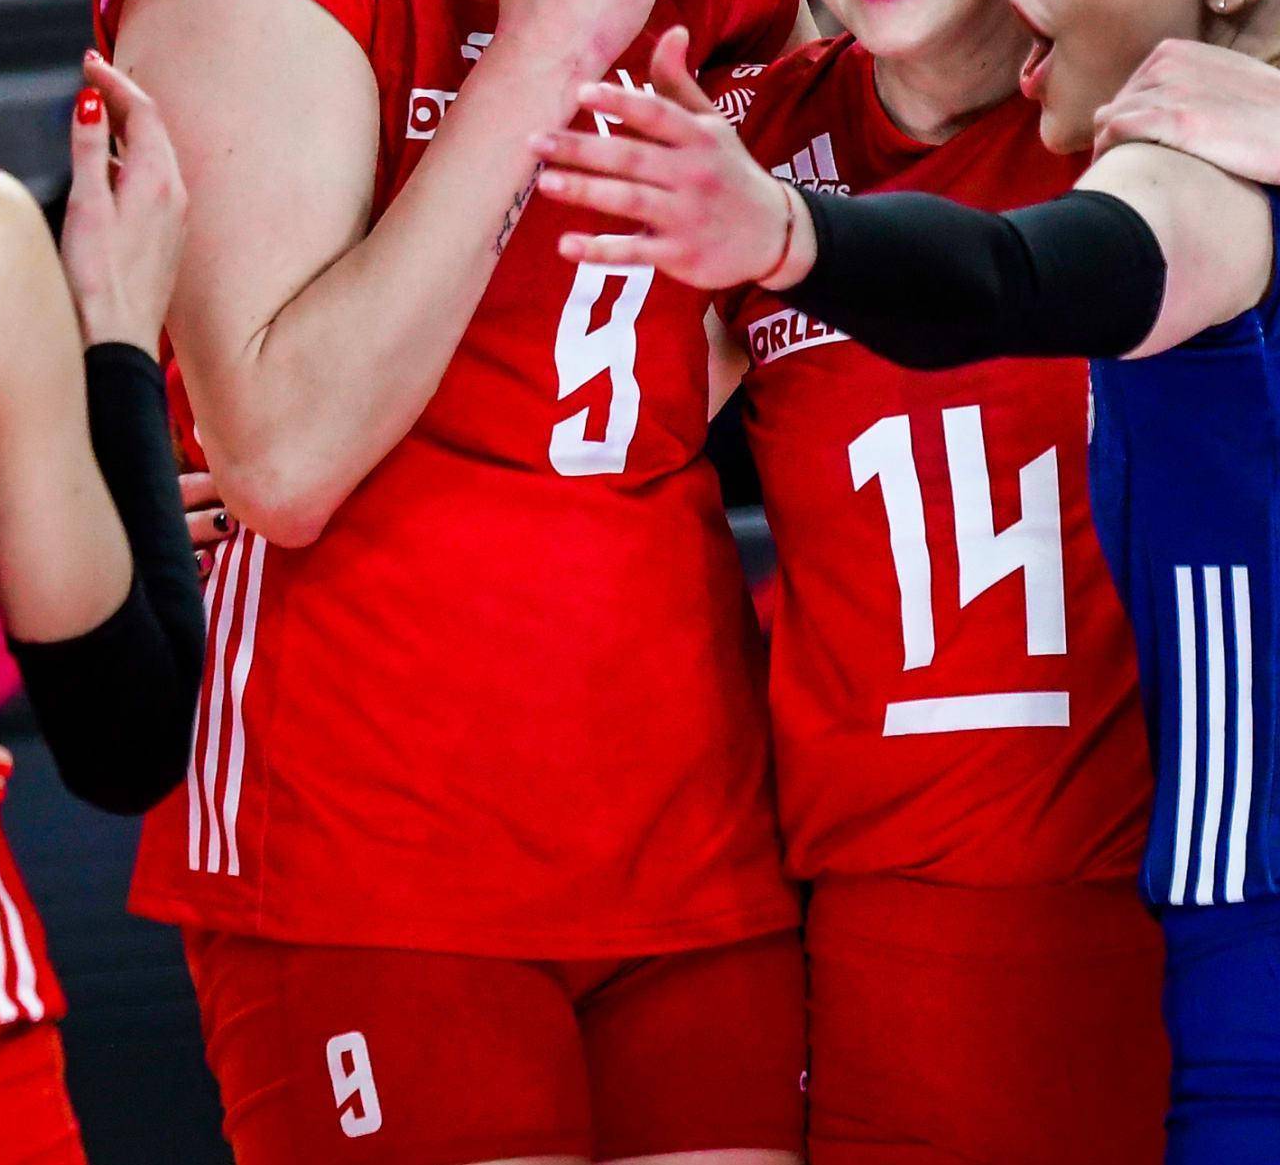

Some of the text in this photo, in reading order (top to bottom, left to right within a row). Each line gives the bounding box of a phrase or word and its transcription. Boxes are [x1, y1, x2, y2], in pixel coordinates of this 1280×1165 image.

[547, 233, 656, 477] 9
[846, 403, 1068, 672] 14
[325, 1030, 383, 1139] 9
